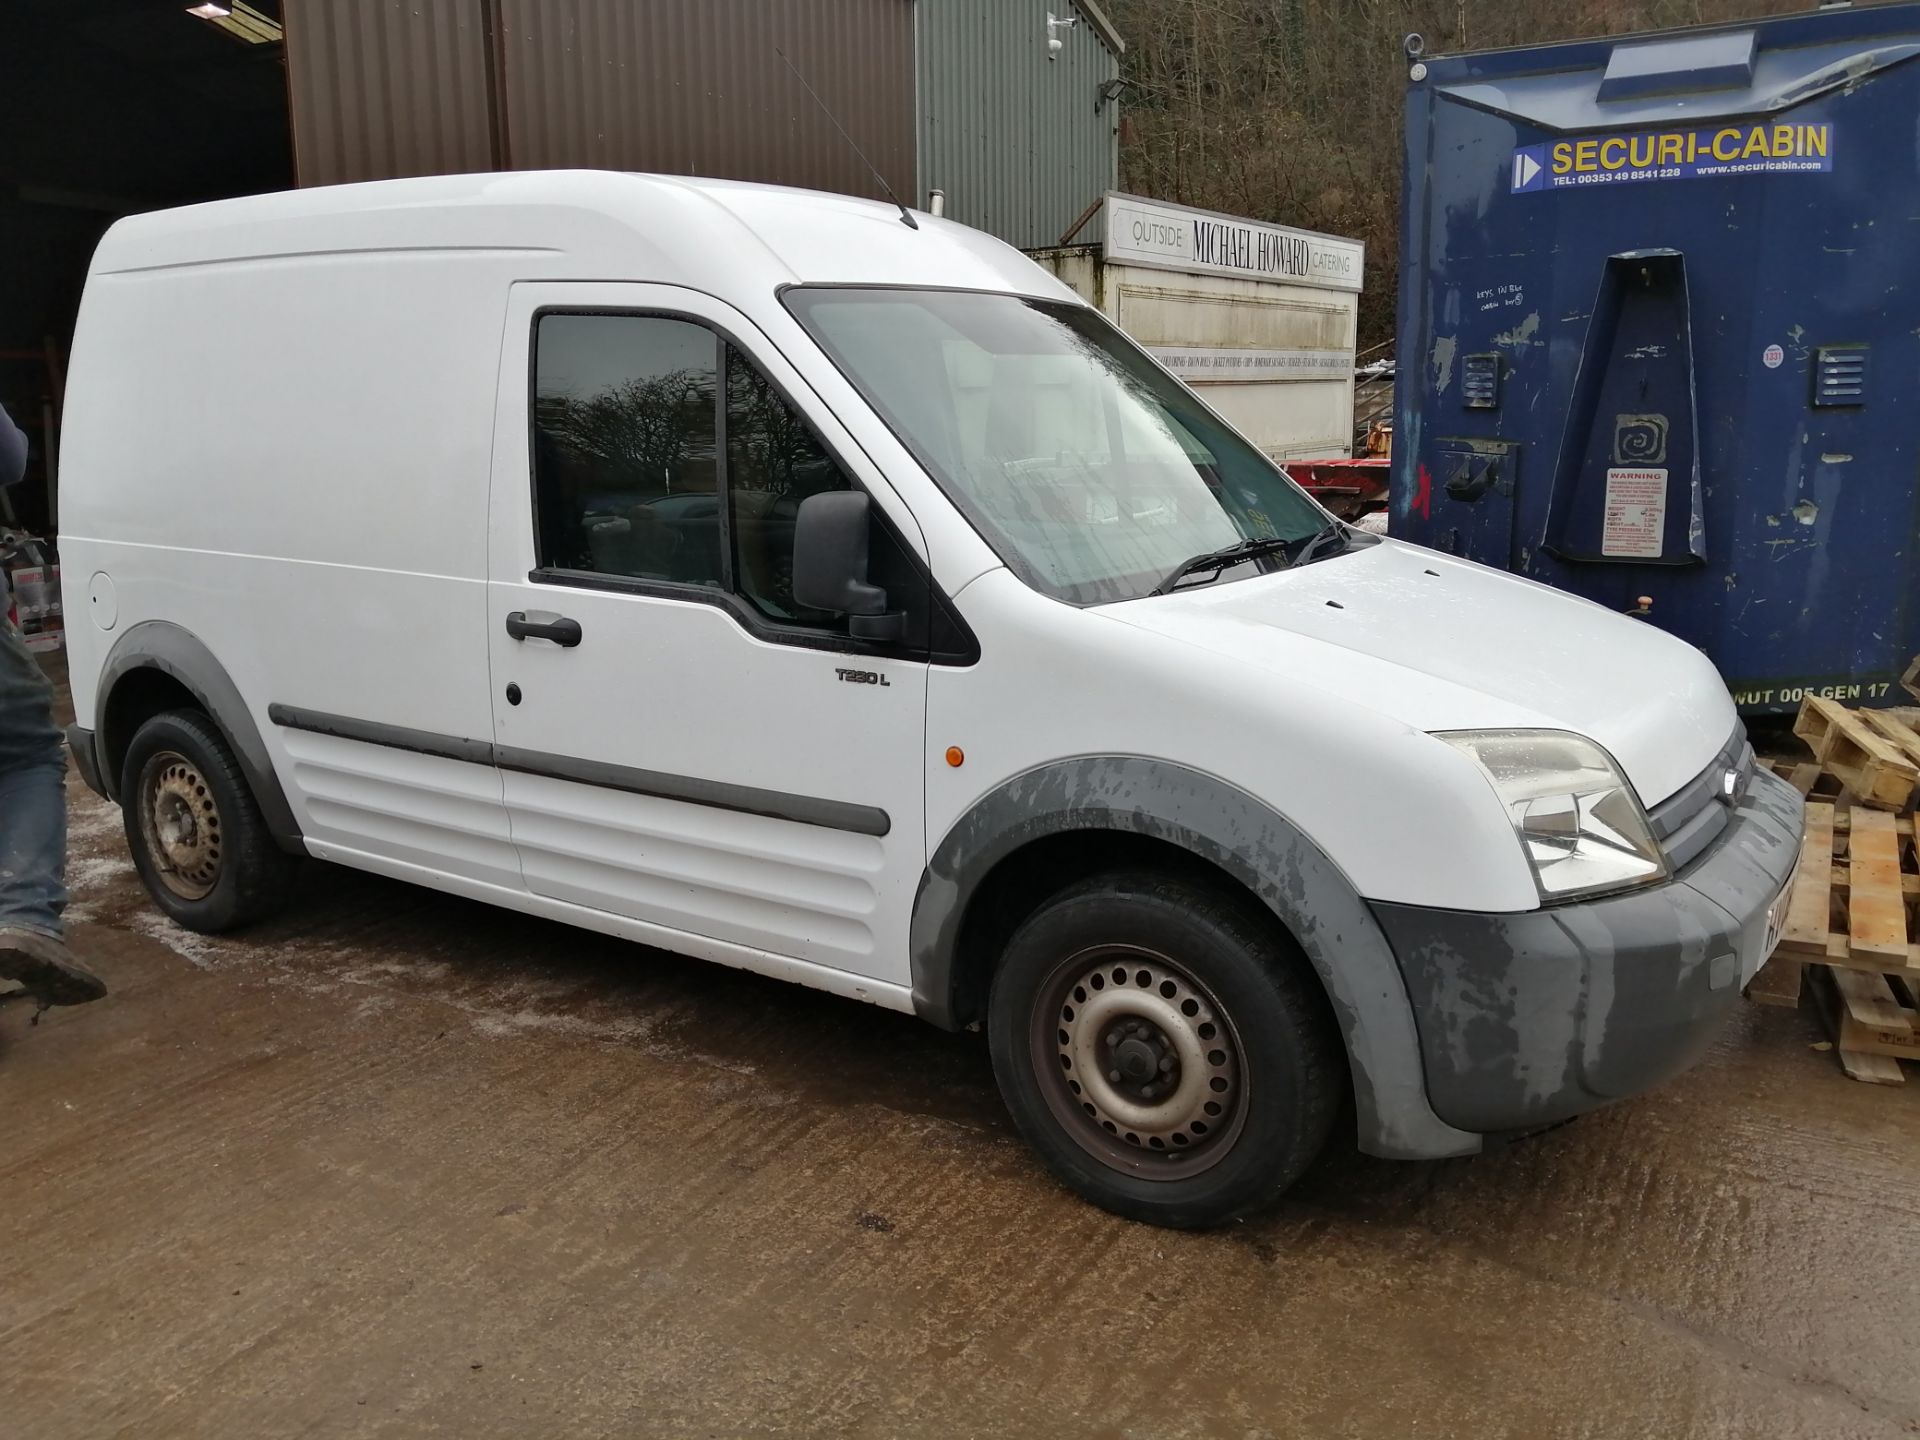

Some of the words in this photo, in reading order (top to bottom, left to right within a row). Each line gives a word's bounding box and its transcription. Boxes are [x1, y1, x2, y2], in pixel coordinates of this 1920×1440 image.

[1552, 126, 1827, 174] SECURI-CABIN
[1553, 177, 1575, 186] TEL:
[1578, 173, 1612, 184] 00353
[1614, 172, 1629, 181] 49
[1631, 168, 1681, 180] 8541228
[1696, 161, 1821, 175] www.securicabin.com
[1132, 220, 1182, 248] OUTSIDE
[1193, 220, 1254, 270] MICHAEL
[1257, 232, 1310, 276] HOWARD
[1312, 252, 1351, 273] CATERING
[1610, 472, 1661, 480] WARNING
[880, 673, 891, 687] L
[1820, 684, 1860, 700] GEN
[1867, 683, 1890, 698] 17
